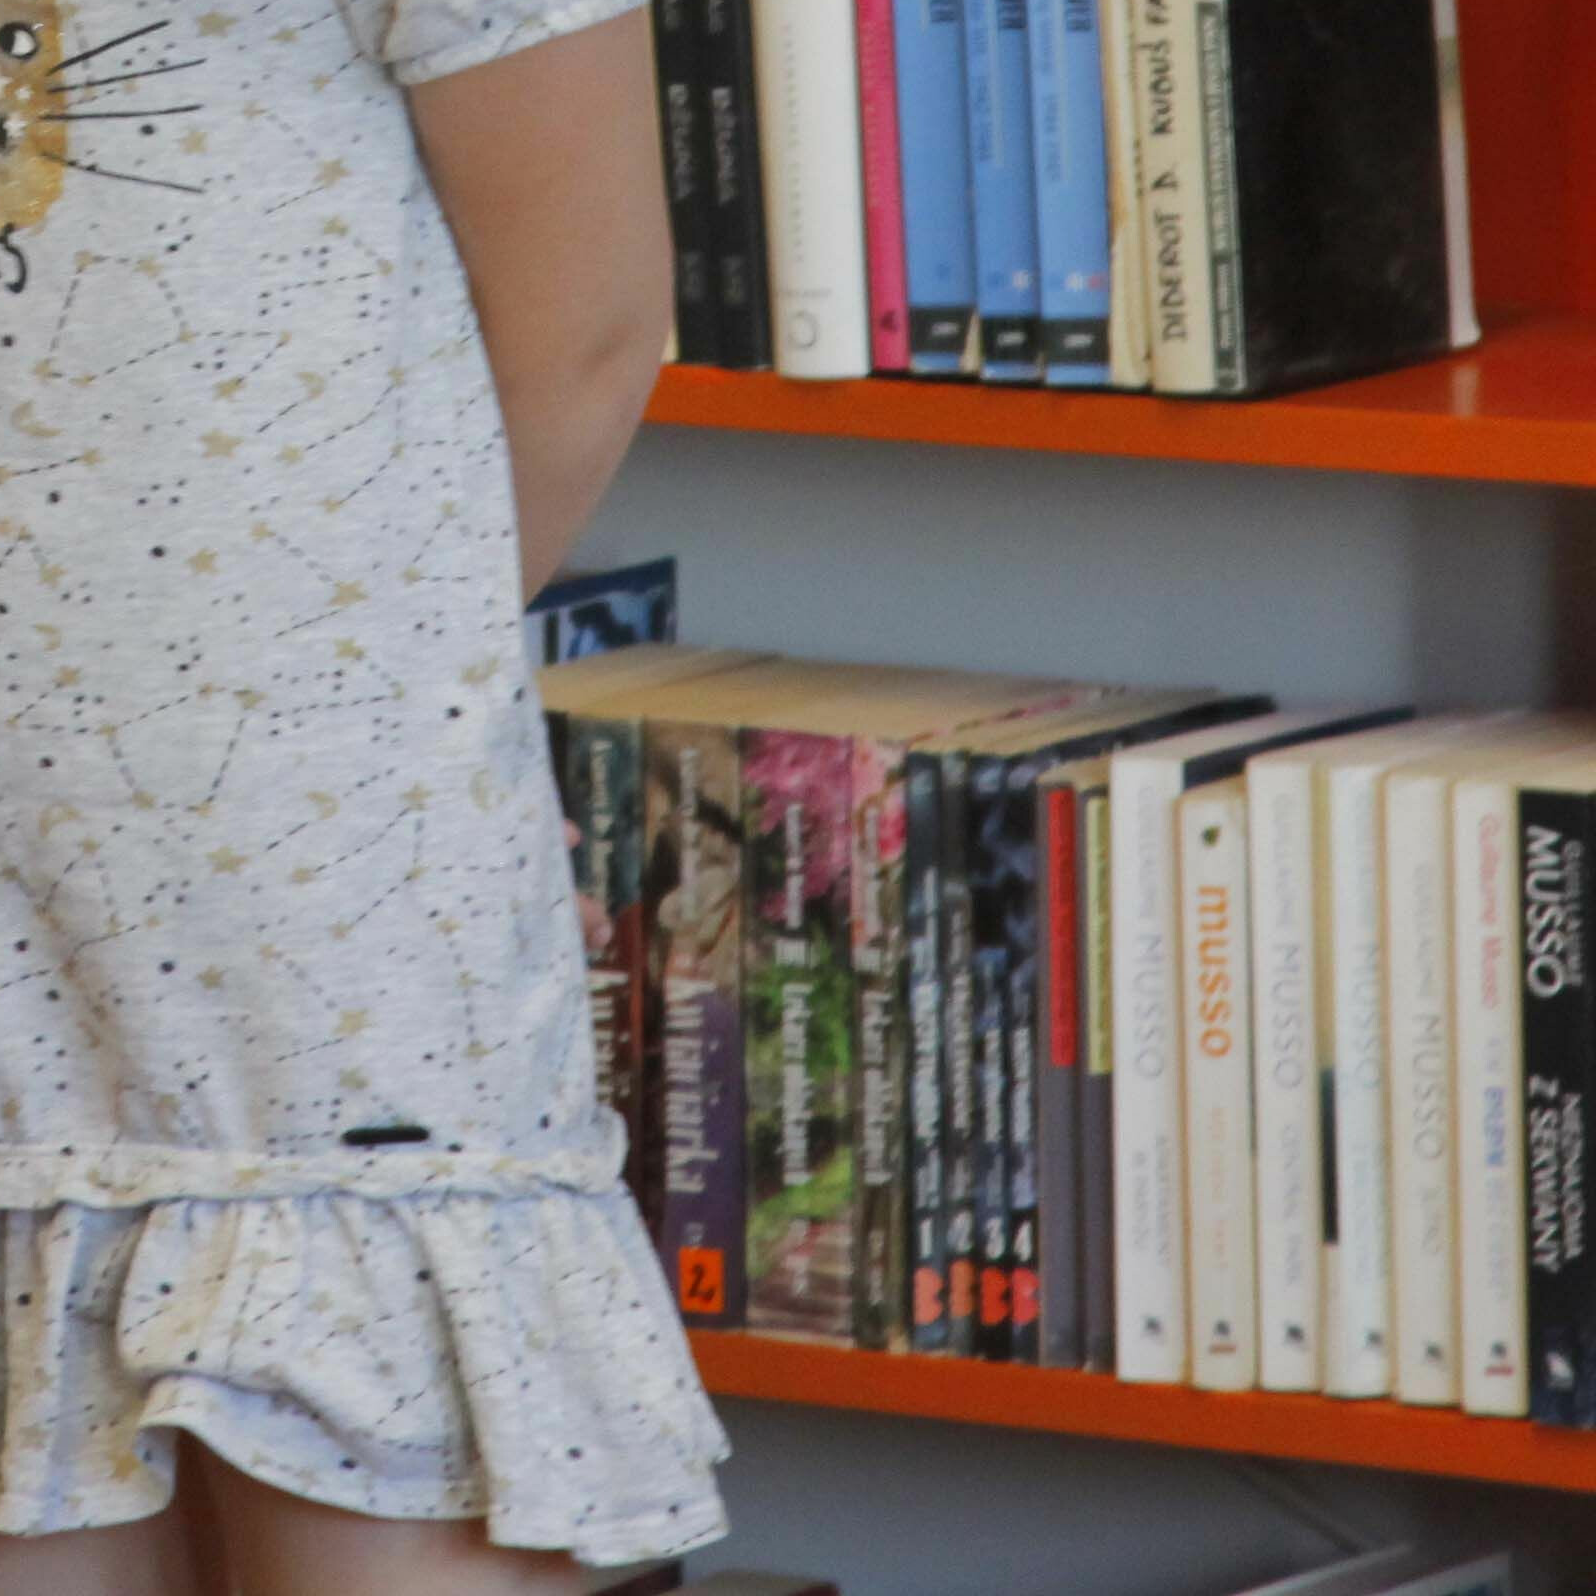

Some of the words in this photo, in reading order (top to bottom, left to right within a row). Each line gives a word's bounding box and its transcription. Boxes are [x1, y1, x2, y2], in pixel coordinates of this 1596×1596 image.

[1136, 37, 1175, 137] KUBUŚ
[1152, 208, 1190, 343] DIDEROT
[1195, 884, 1233, 1060] musso
[1523, 824, 1565, 1000] MUSSO
[1132, 932, 1165, 1082] MUSSO
[1270, 942, 1304, 1092] MUSSO
[1351, 940, 1382, 1093] MUSSO
[1409, 1012, 1446, 1163] MUSSO
[1527, 1107, 1562, 1276] SEKWANY
[686, 1256, 717, 1302] 2
